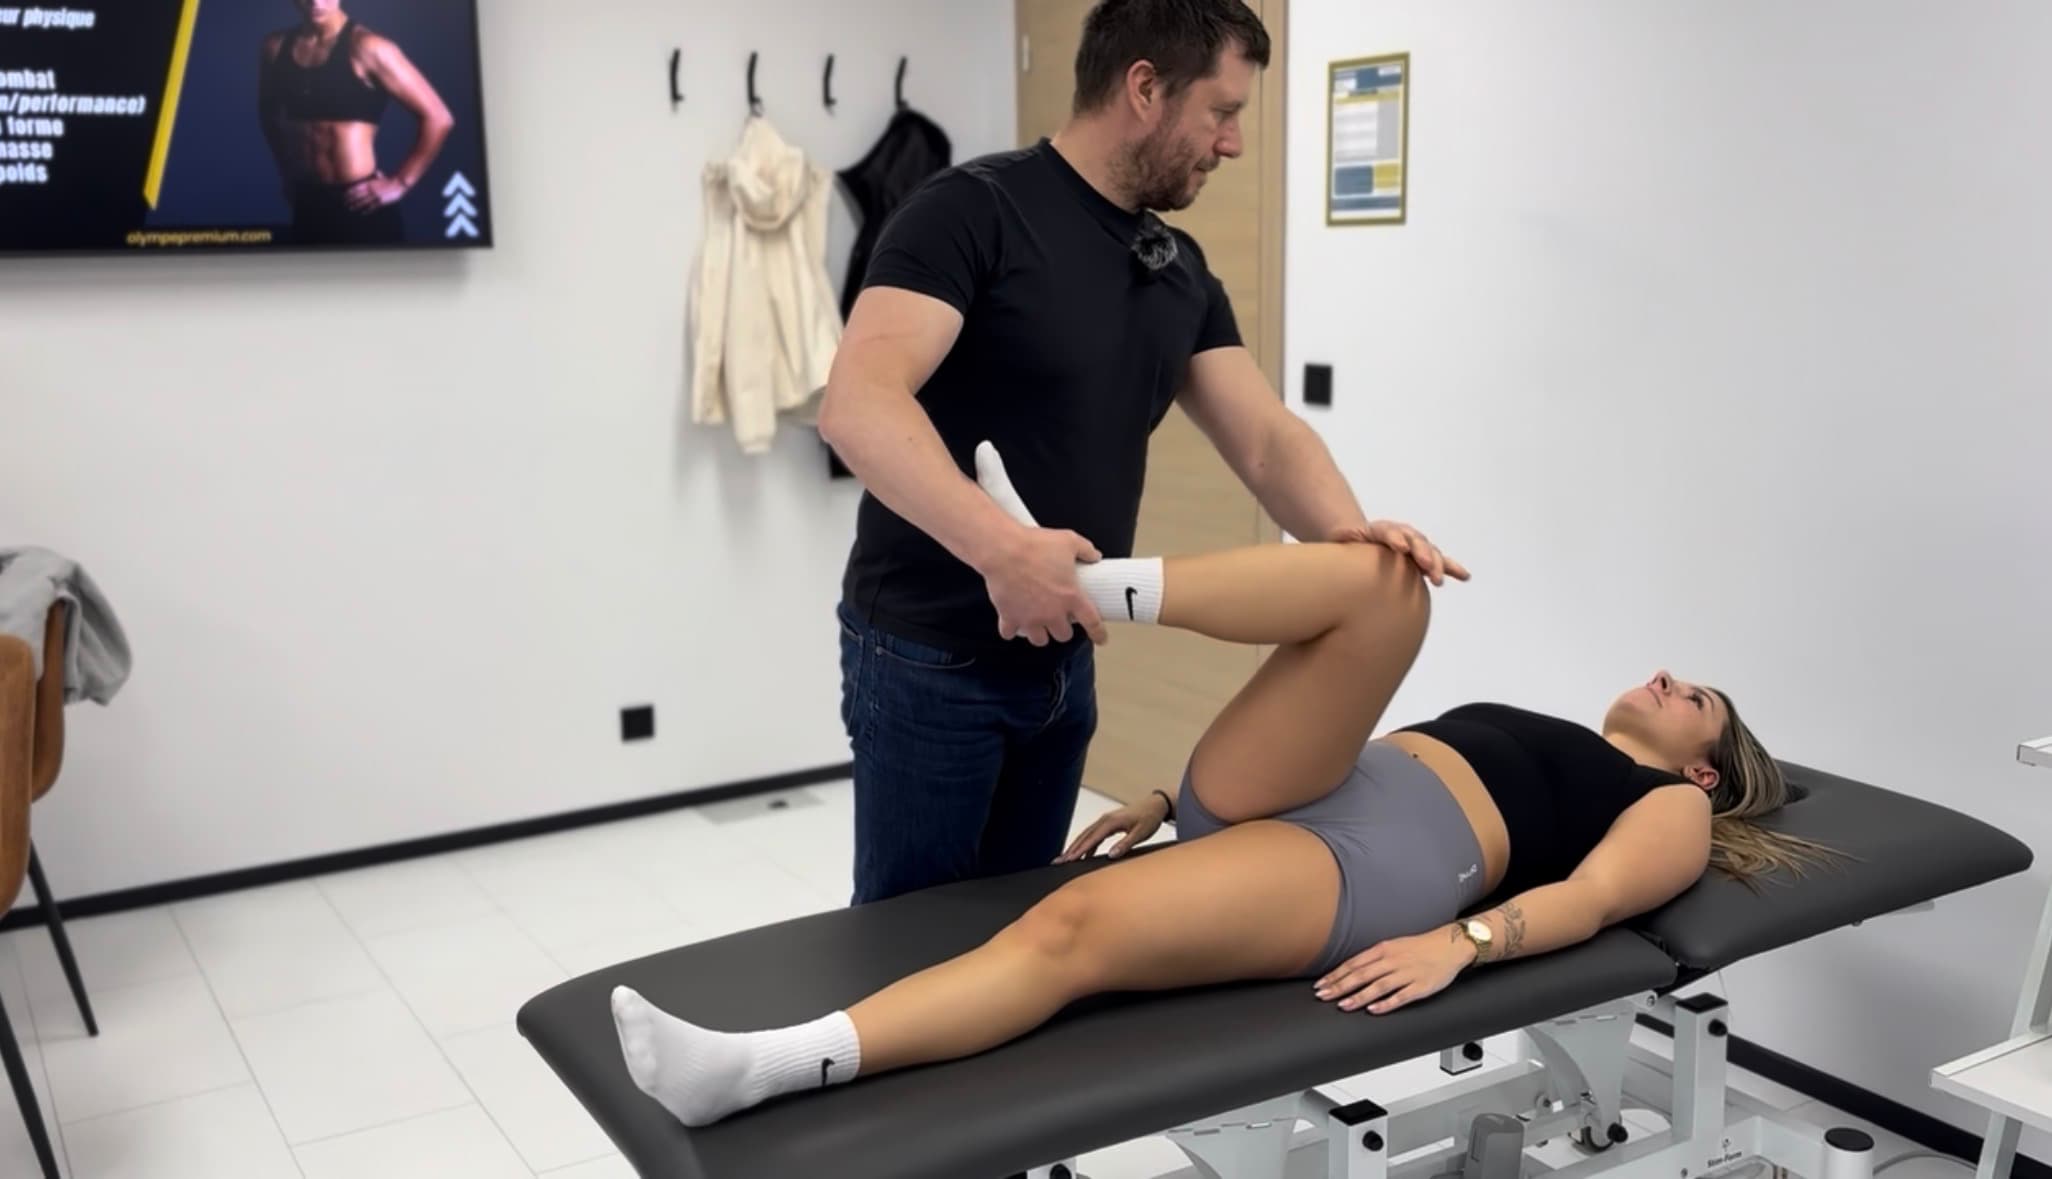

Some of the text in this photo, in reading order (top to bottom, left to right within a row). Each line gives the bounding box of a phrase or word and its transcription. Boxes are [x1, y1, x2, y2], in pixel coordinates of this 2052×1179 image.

[22, 7, 96, 29] physique
[8, 116, 64, 135] forme
[126, 230, 273, 246] olympepremium.com
